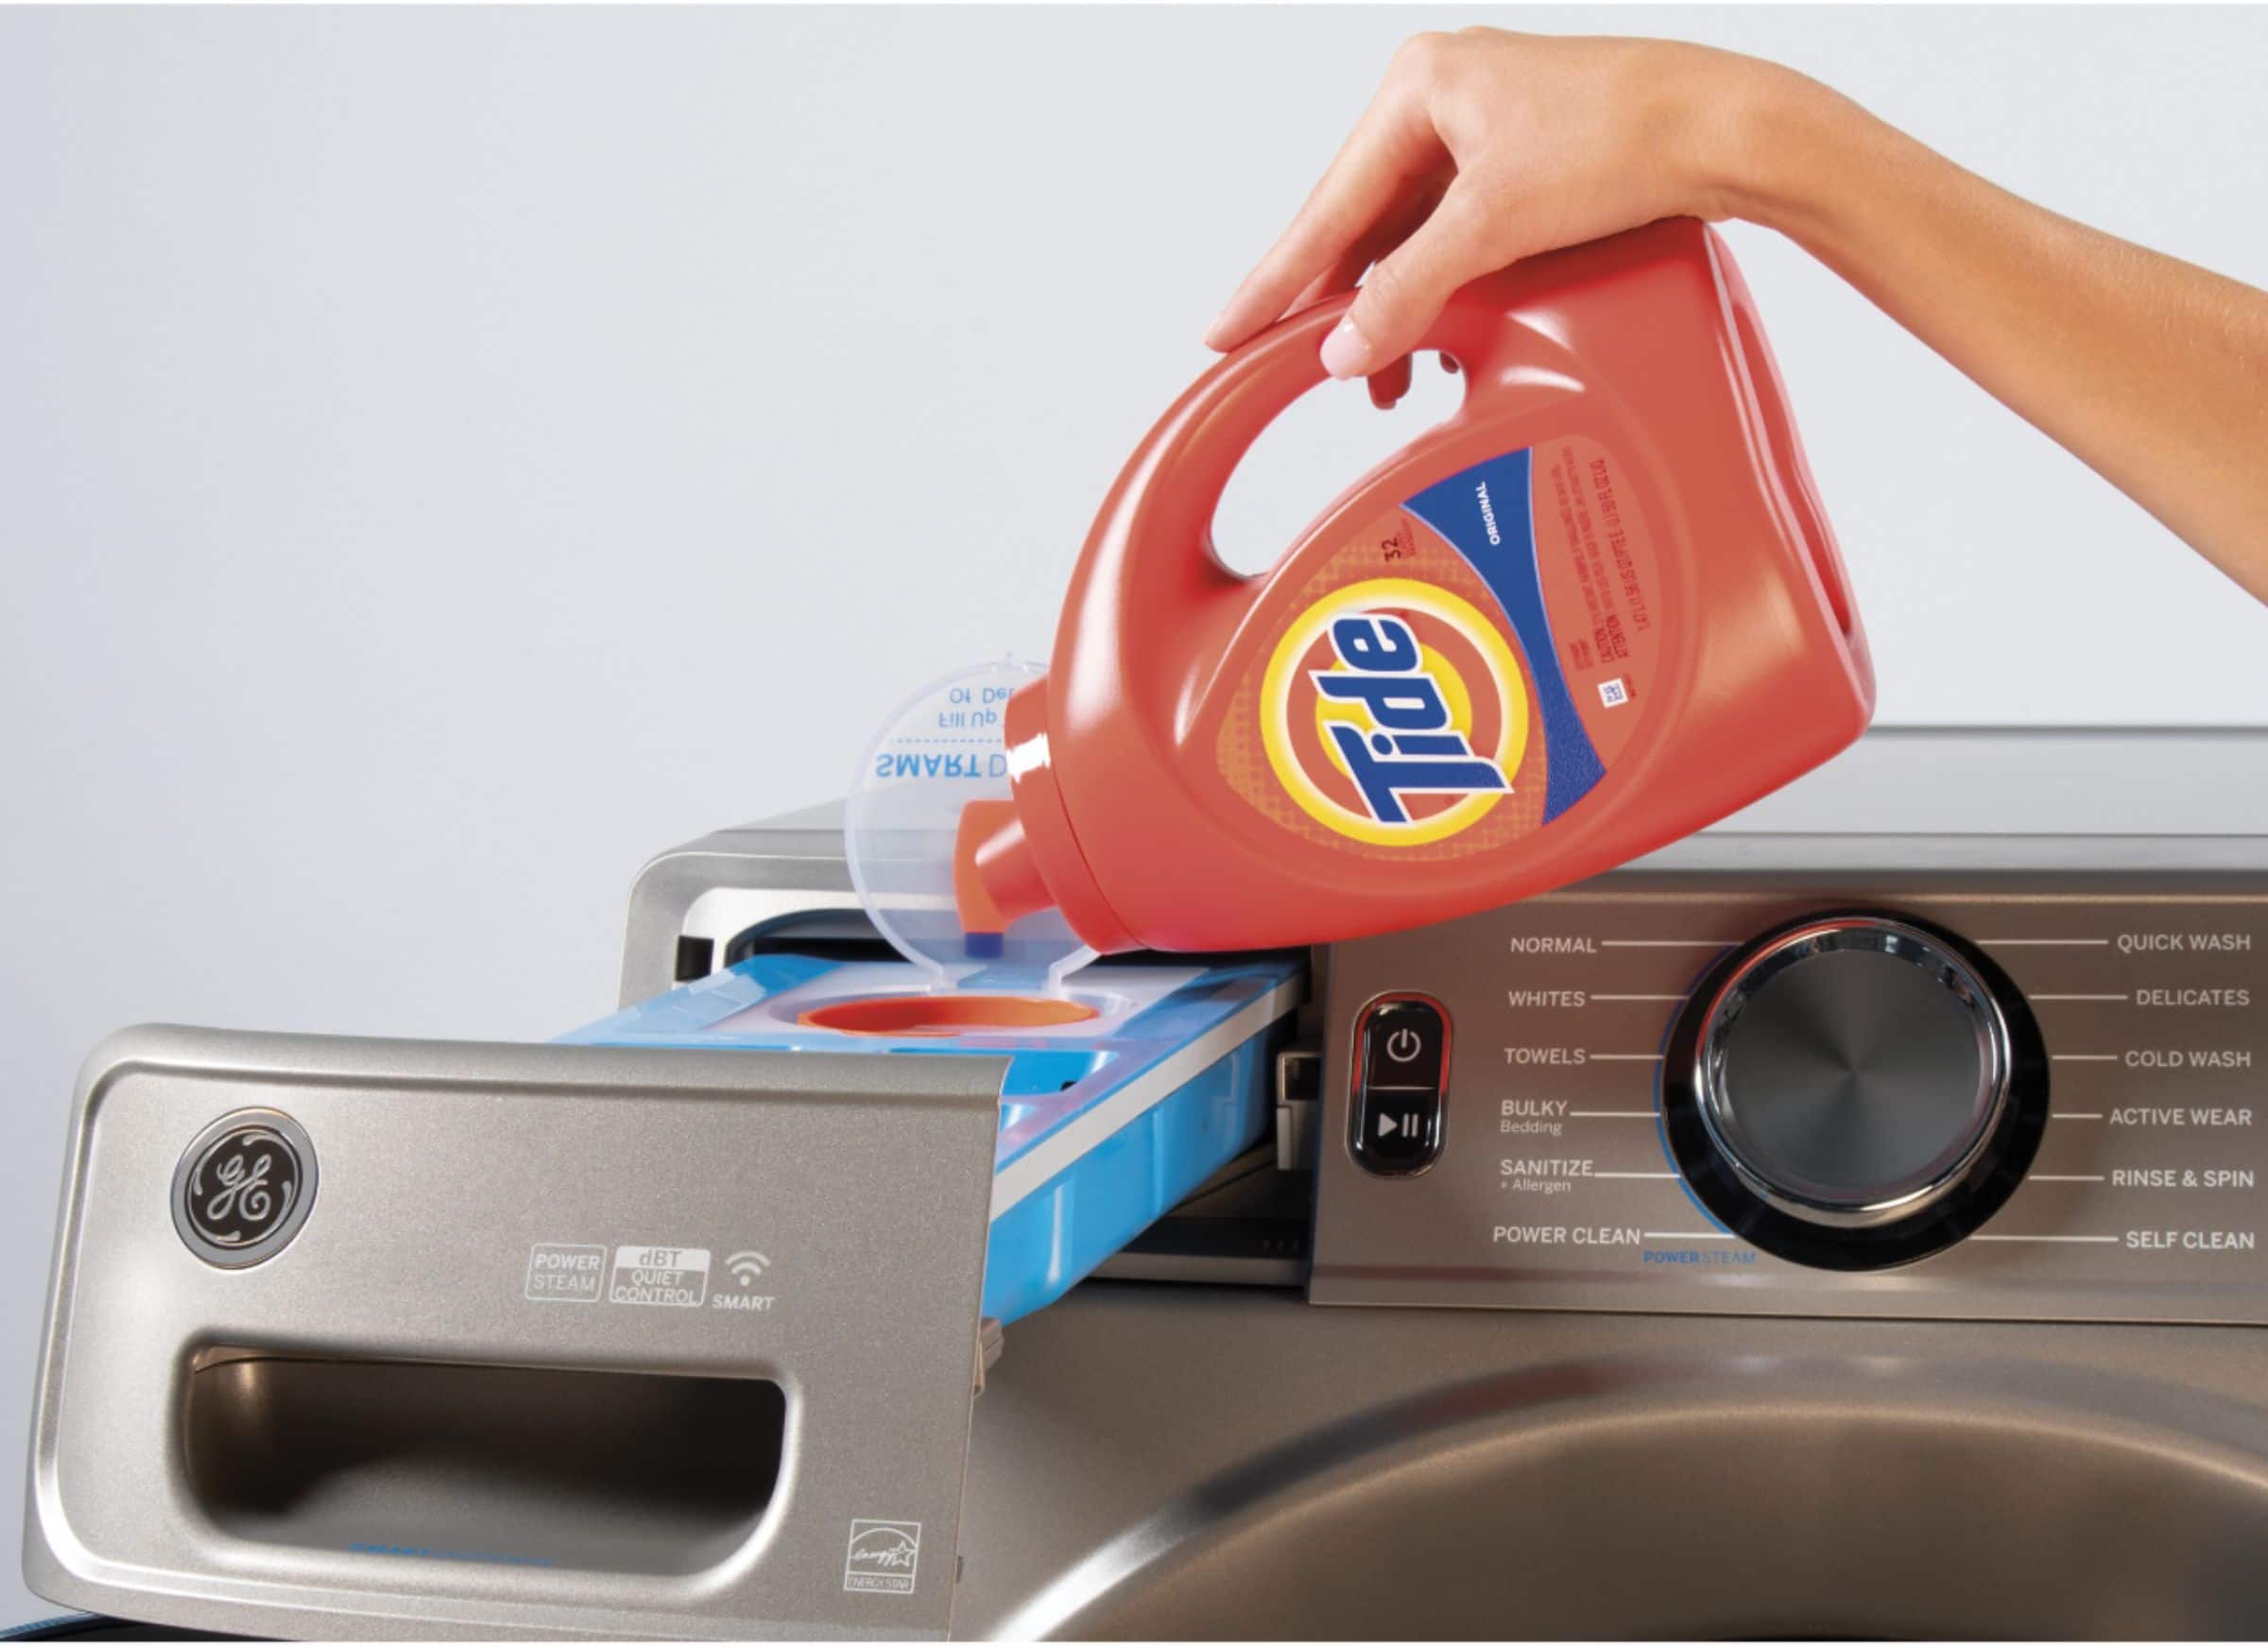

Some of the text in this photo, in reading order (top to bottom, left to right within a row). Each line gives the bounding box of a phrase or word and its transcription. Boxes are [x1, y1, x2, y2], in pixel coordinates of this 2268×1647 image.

[1475, 481, 1501, 545] ORIGINAL
[1382, 538, 1401, 561] 32
[1308, 612, 1514, 824] Tide
[1510, 937, 1597, 953] NORMAL
[2118, 935, 2251, 952] QUICK WASH
[1508, 991, 1586, 1006] WHITES
[2136, 990, 2250, 1005] DELICATES
[1504, 1048, 1586, 1064] TOWELS
[2124, 1051, 2251, 1067] COLD WASH
[1501, 1100, 1568, 1117] BULKY
[2109, 1108, 2252, 1125] ACTIVE WEAR
[1501, 1120, 1562, 1135] Bedding
[1501, 1159, 1593, 1176] SANITIZE
[1513, 1178, 1571, 1192] Allergen
[2112, 1170, 2255, 1188] RINSE & SPIN
[1493, 1227, 1641, 1244] POWER CLEAN
[2126, 1231, 2255, 1249] SELF CLEAN
[536, 1254, 600, 1270] POWER
[639, 1250, 681, 1266] dBT
[533, 1274, 595, 1291] STEAM
[630, 1270, 683, 1286] QUIET
[615, 1286, 696, 1304] CONTROL
[713, 1294, 775, 1311] SMART
